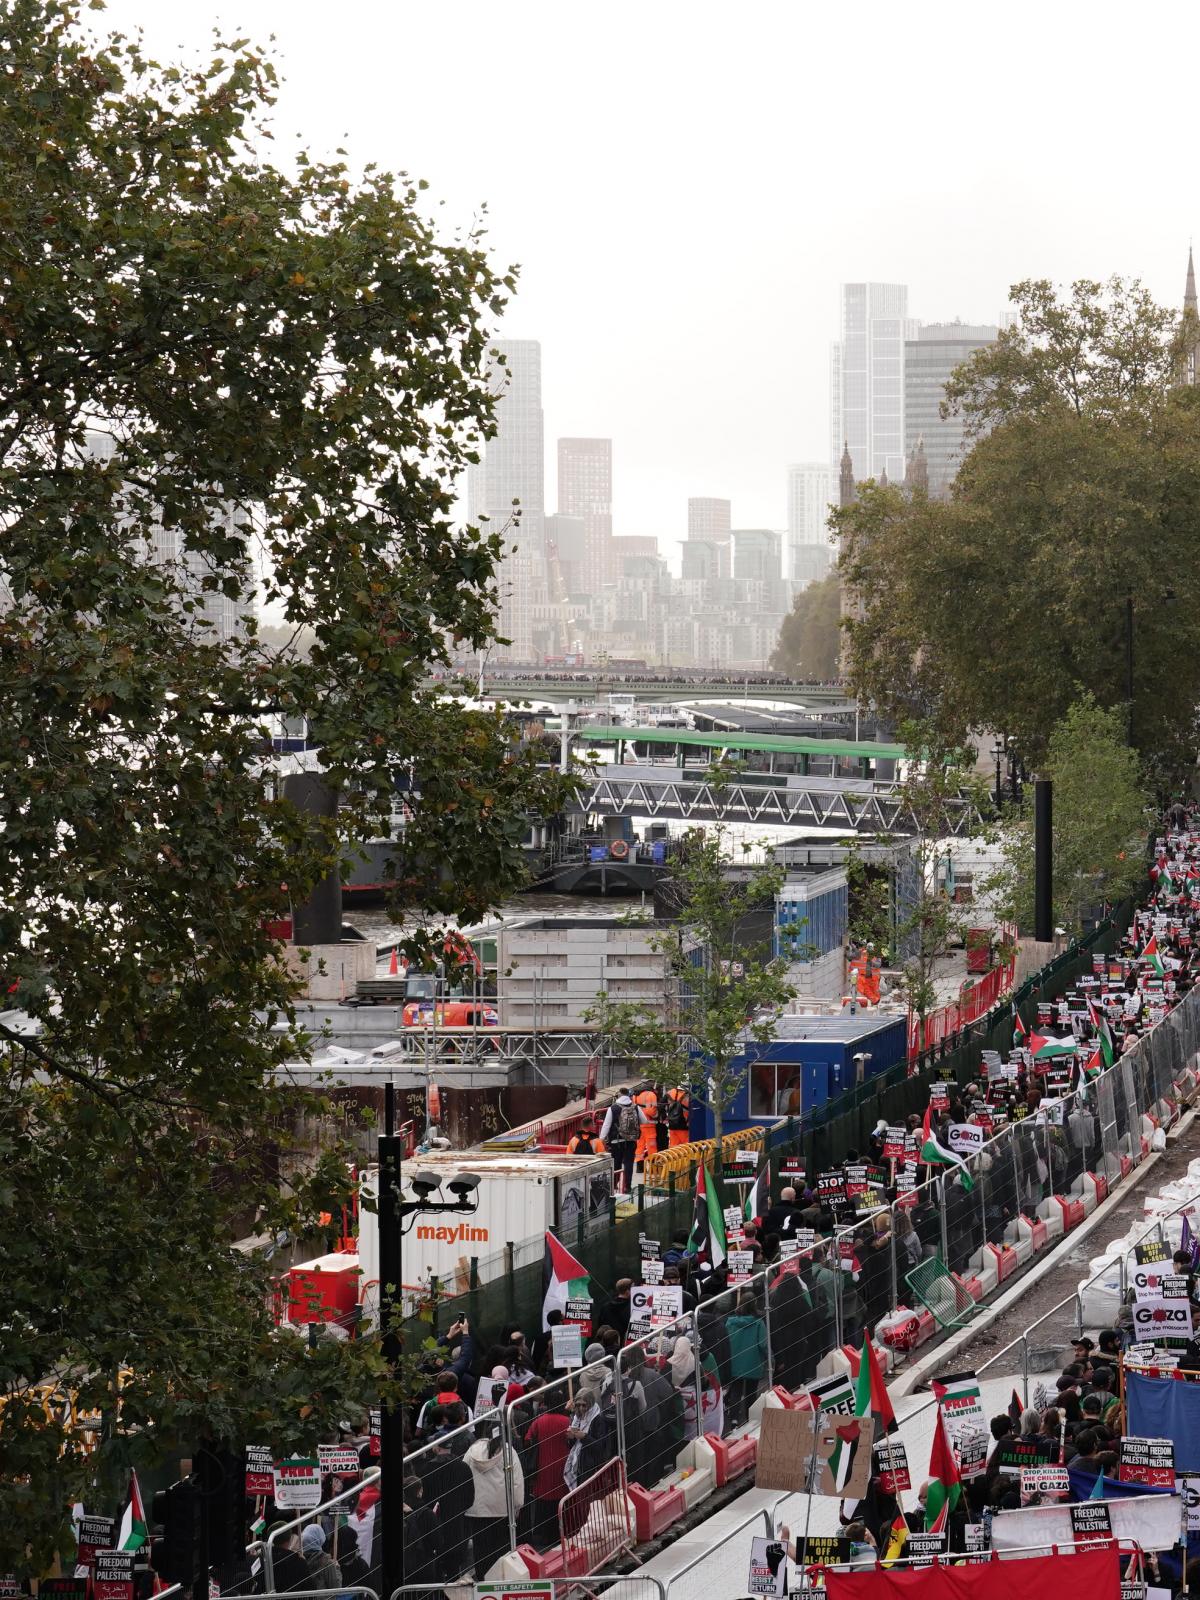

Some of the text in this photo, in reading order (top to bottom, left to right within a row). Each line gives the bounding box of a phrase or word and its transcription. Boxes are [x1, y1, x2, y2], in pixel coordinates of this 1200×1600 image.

[949, 1130, 980, 1142] Gza
[818, 1177, 844, 1188] STOP
[416, 1223, 488, 1244] maylim
[1163, 1279, 1187, 1289] FREEDOM
[1163, 1289, 1188, 1298] PALESTINE
[567, 1303, 590, 1311] FREEDOM
[1135, 1307, 1187, 1324] Gza
[1137, 1326, 1150, 1334] Stop
[1015, 1445, 1036, 1455] FREE
[1150, 1446, 1172, 1456] FREEDOM
[1001, 1452, 1049, 1464] PALESTINE
[1149, 1458, 1173, 1468] PALESTINE
[280, 1466, 314, 1478] FREE
[332, 1464, 357, 1472] GAZA
[1042, 1467, 1067, 1475] KILLING
[275, 1477, 319, 1487] PALESTINE
[1024, 1481, 1069, 1491] IN GAZA
[1074, 1508, 1106, 1518] FREEDOM
[82, 1522, 111, 1534] FREEDOM
[1074, 1521, 1110, 1531] PALESTINE
[80, 1534, 111, 1546] PALESTINE
[808, 1537, 839, 1548] HANDS
[909, 1540, 942, 1551] FREEDOM
[815, 1547, 831, 1556] OFF
[98, 1557, 131, 1568] FREEDOM
[804, 1555, 842, 1565] AL-AQSA
[96, 1570, 132, 1581] PALESTINE
